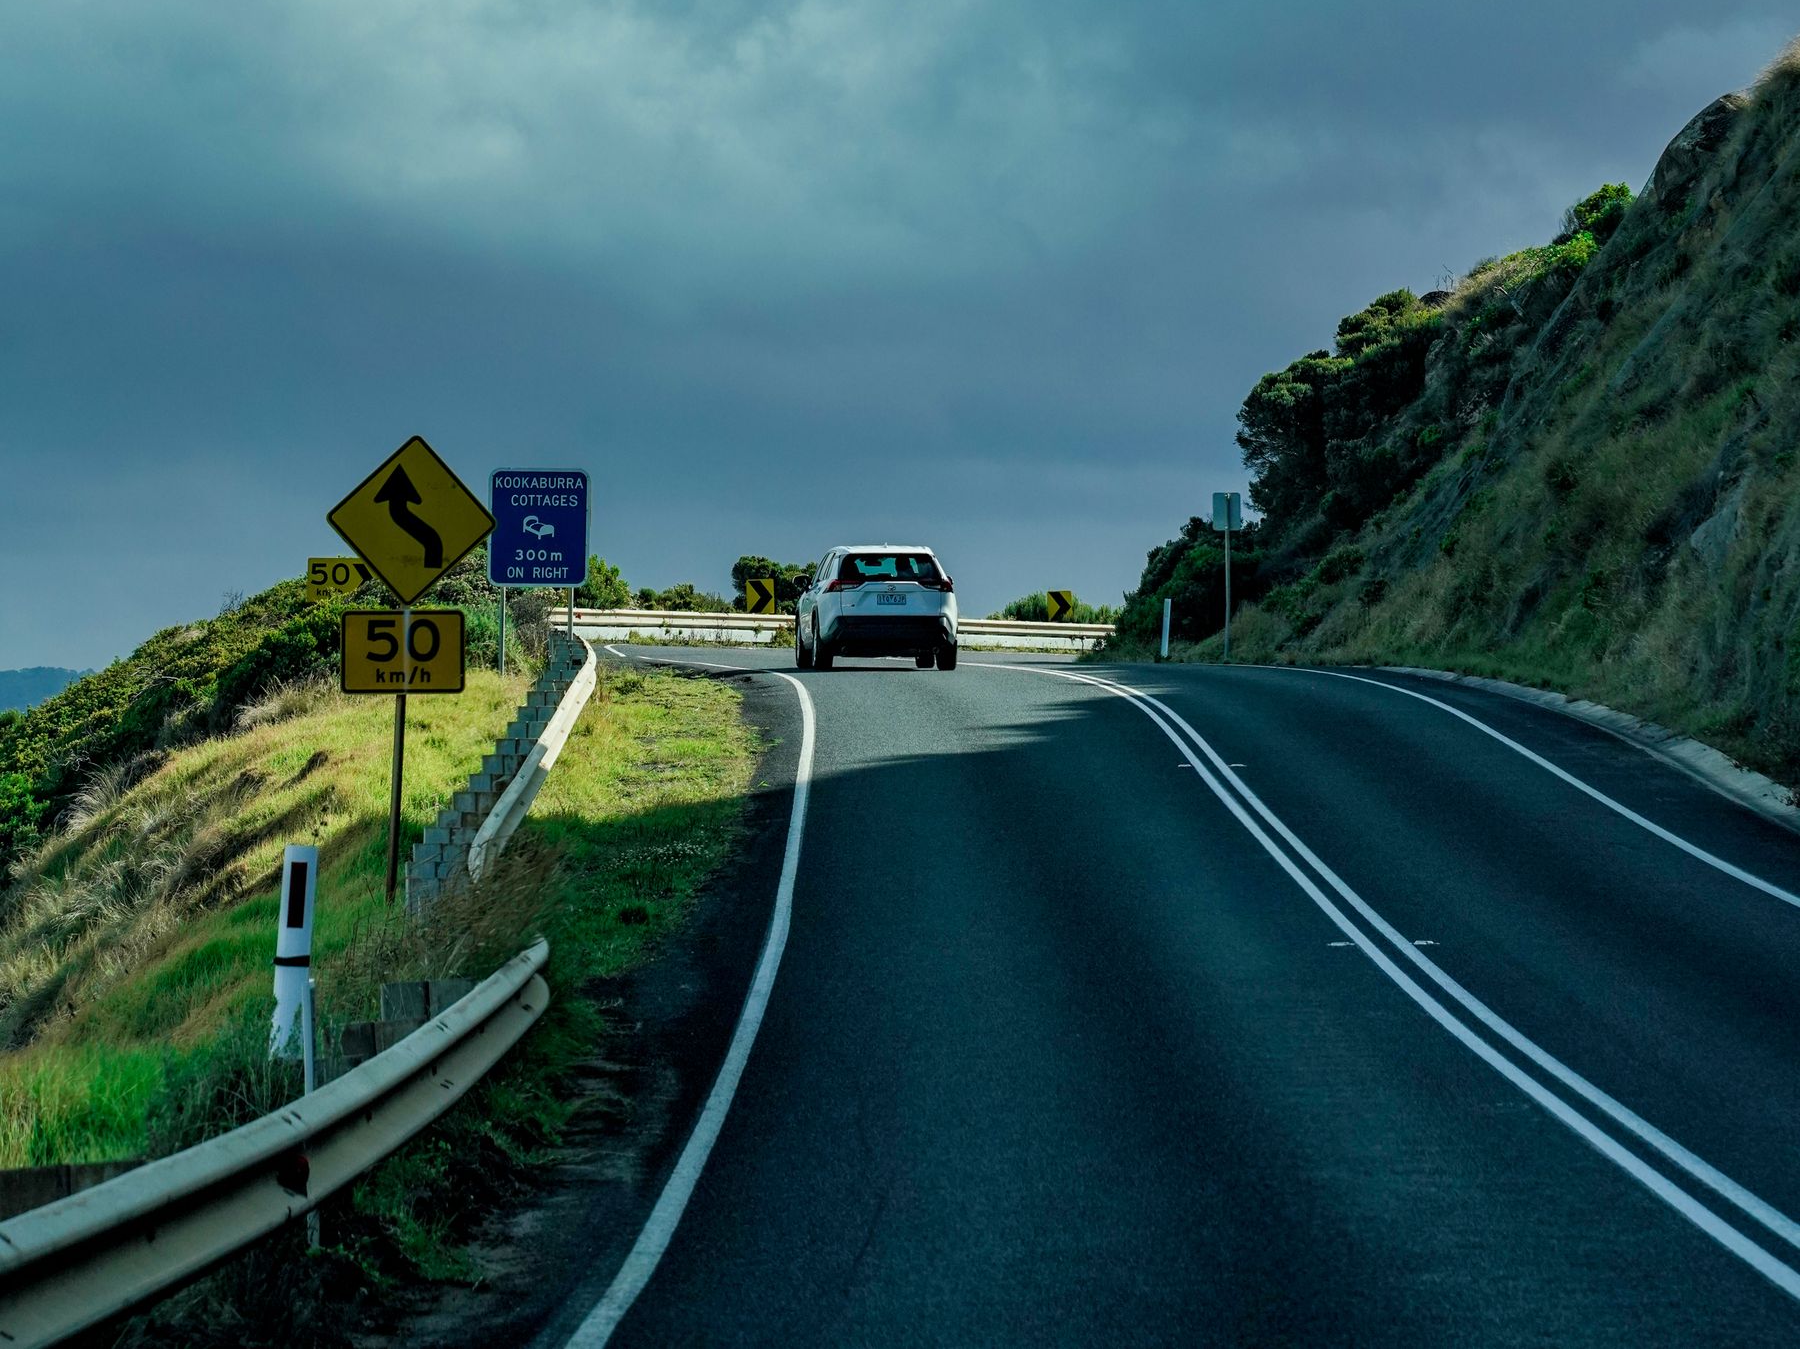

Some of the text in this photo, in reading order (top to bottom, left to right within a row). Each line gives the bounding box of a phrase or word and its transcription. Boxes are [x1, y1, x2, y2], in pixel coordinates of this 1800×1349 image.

[495, 477, 584, 489] KOOKABURRA
[511, 494, 578, 507] COTTAGES
[310, 562, 350, 586] 50
[506, 566, 569, 579] ON RIGHT
[366, 618, 440, 663] 50
[376, 666, 431, 684] km/h
